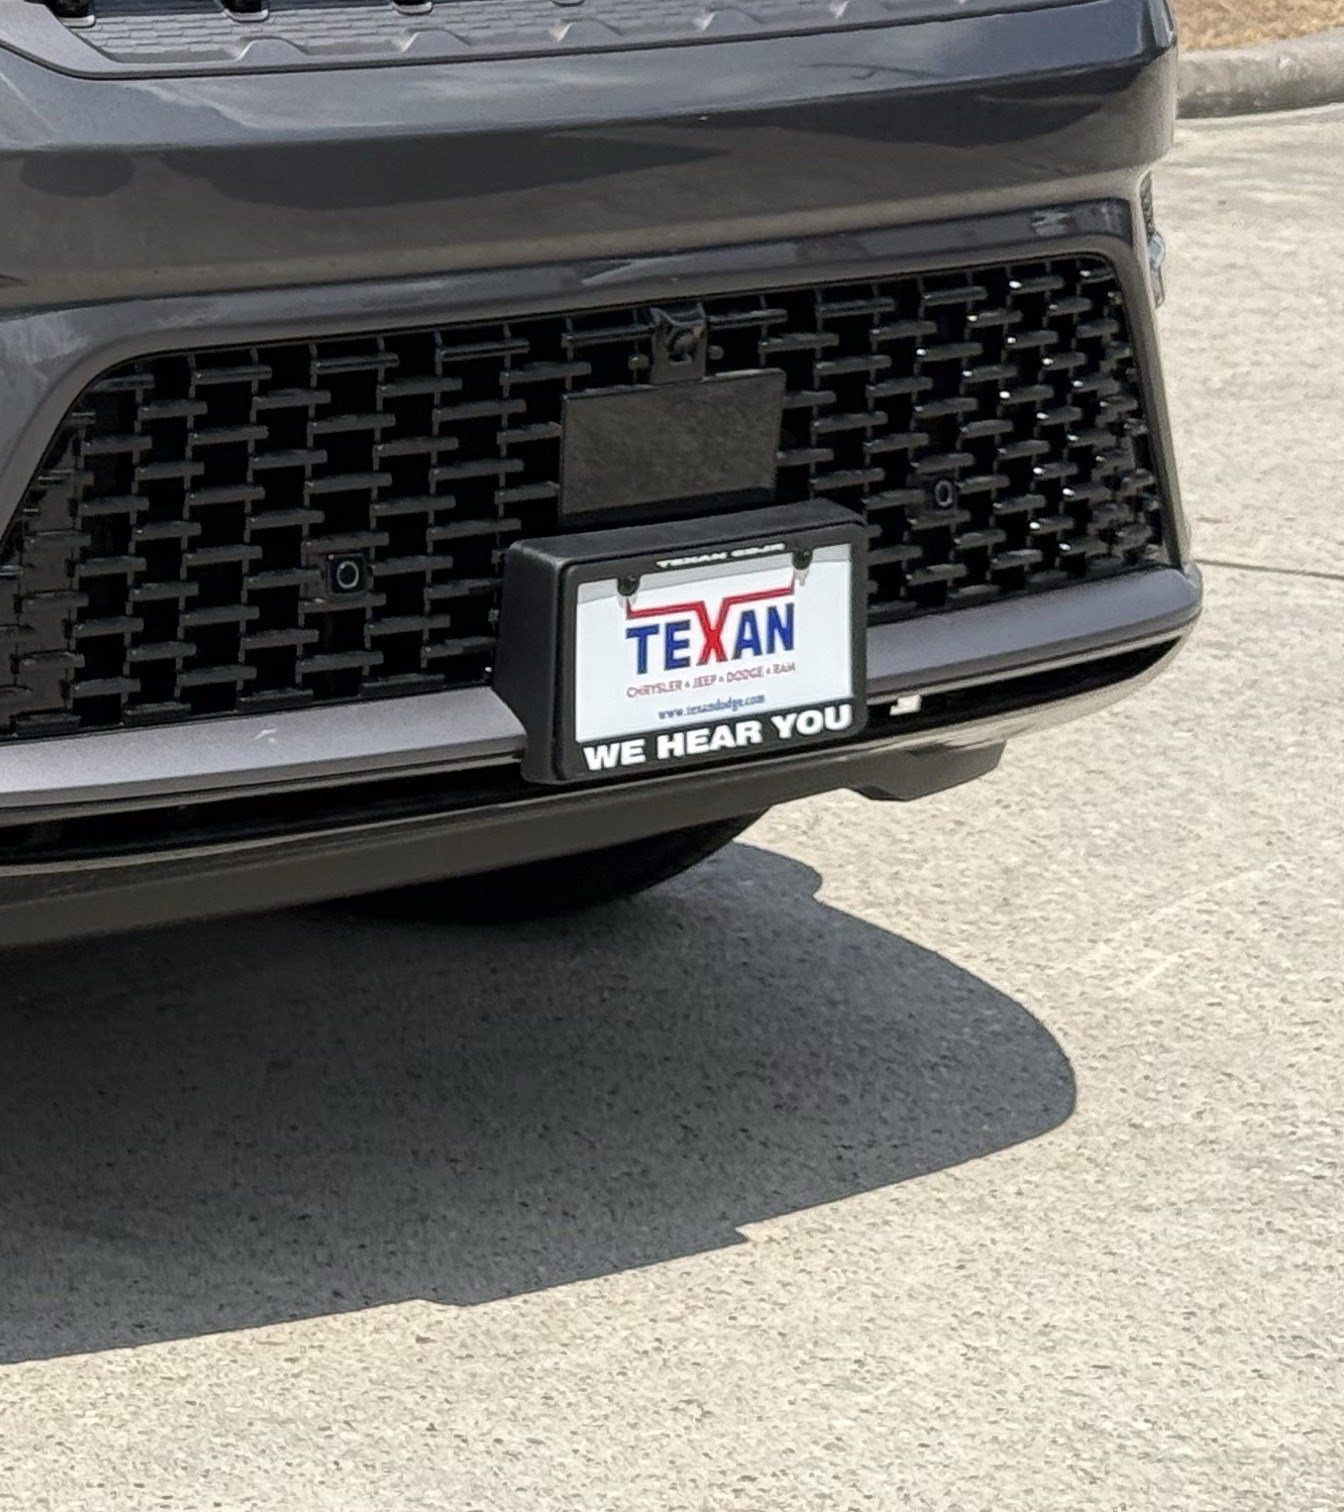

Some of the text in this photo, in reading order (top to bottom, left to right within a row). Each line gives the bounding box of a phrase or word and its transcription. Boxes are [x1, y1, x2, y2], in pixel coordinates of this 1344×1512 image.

[625, 586, 795, 675] TEXAN
[625, 661, 796, 699] CHRYSLER JEEP DODGE RAM
[658, 694, 766, 720] www.texandodge.com
[582, 703, 853, 772] WE HEAR YOU
